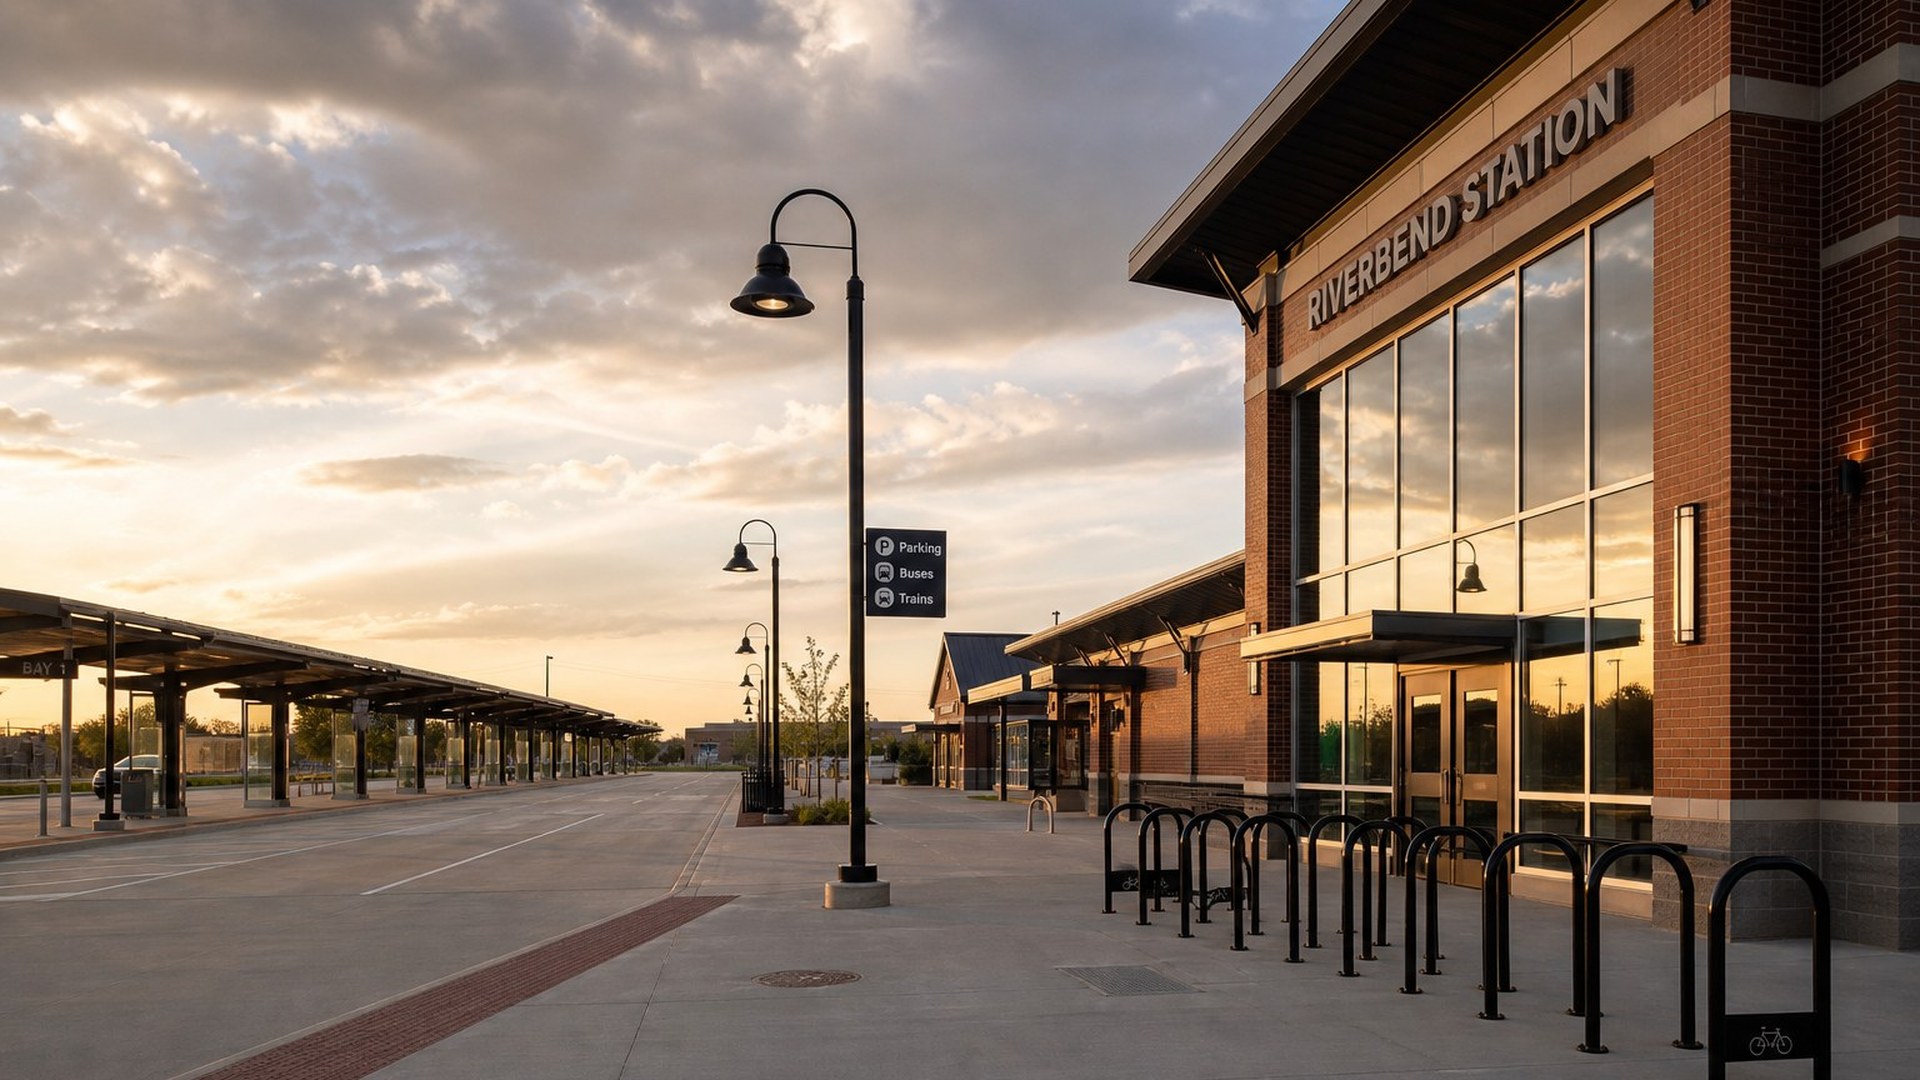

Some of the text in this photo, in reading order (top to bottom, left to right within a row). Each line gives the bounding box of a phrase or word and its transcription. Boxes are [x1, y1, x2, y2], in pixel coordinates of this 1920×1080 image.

[1308, 67, 1623, 331] RIVERBEND STATION
[899, 542, 941, 556] Parking
[899, 568, 934, 579] Buses
[899, 593, 934, 605] Trains
[22, 662, 52, 675] BAY
